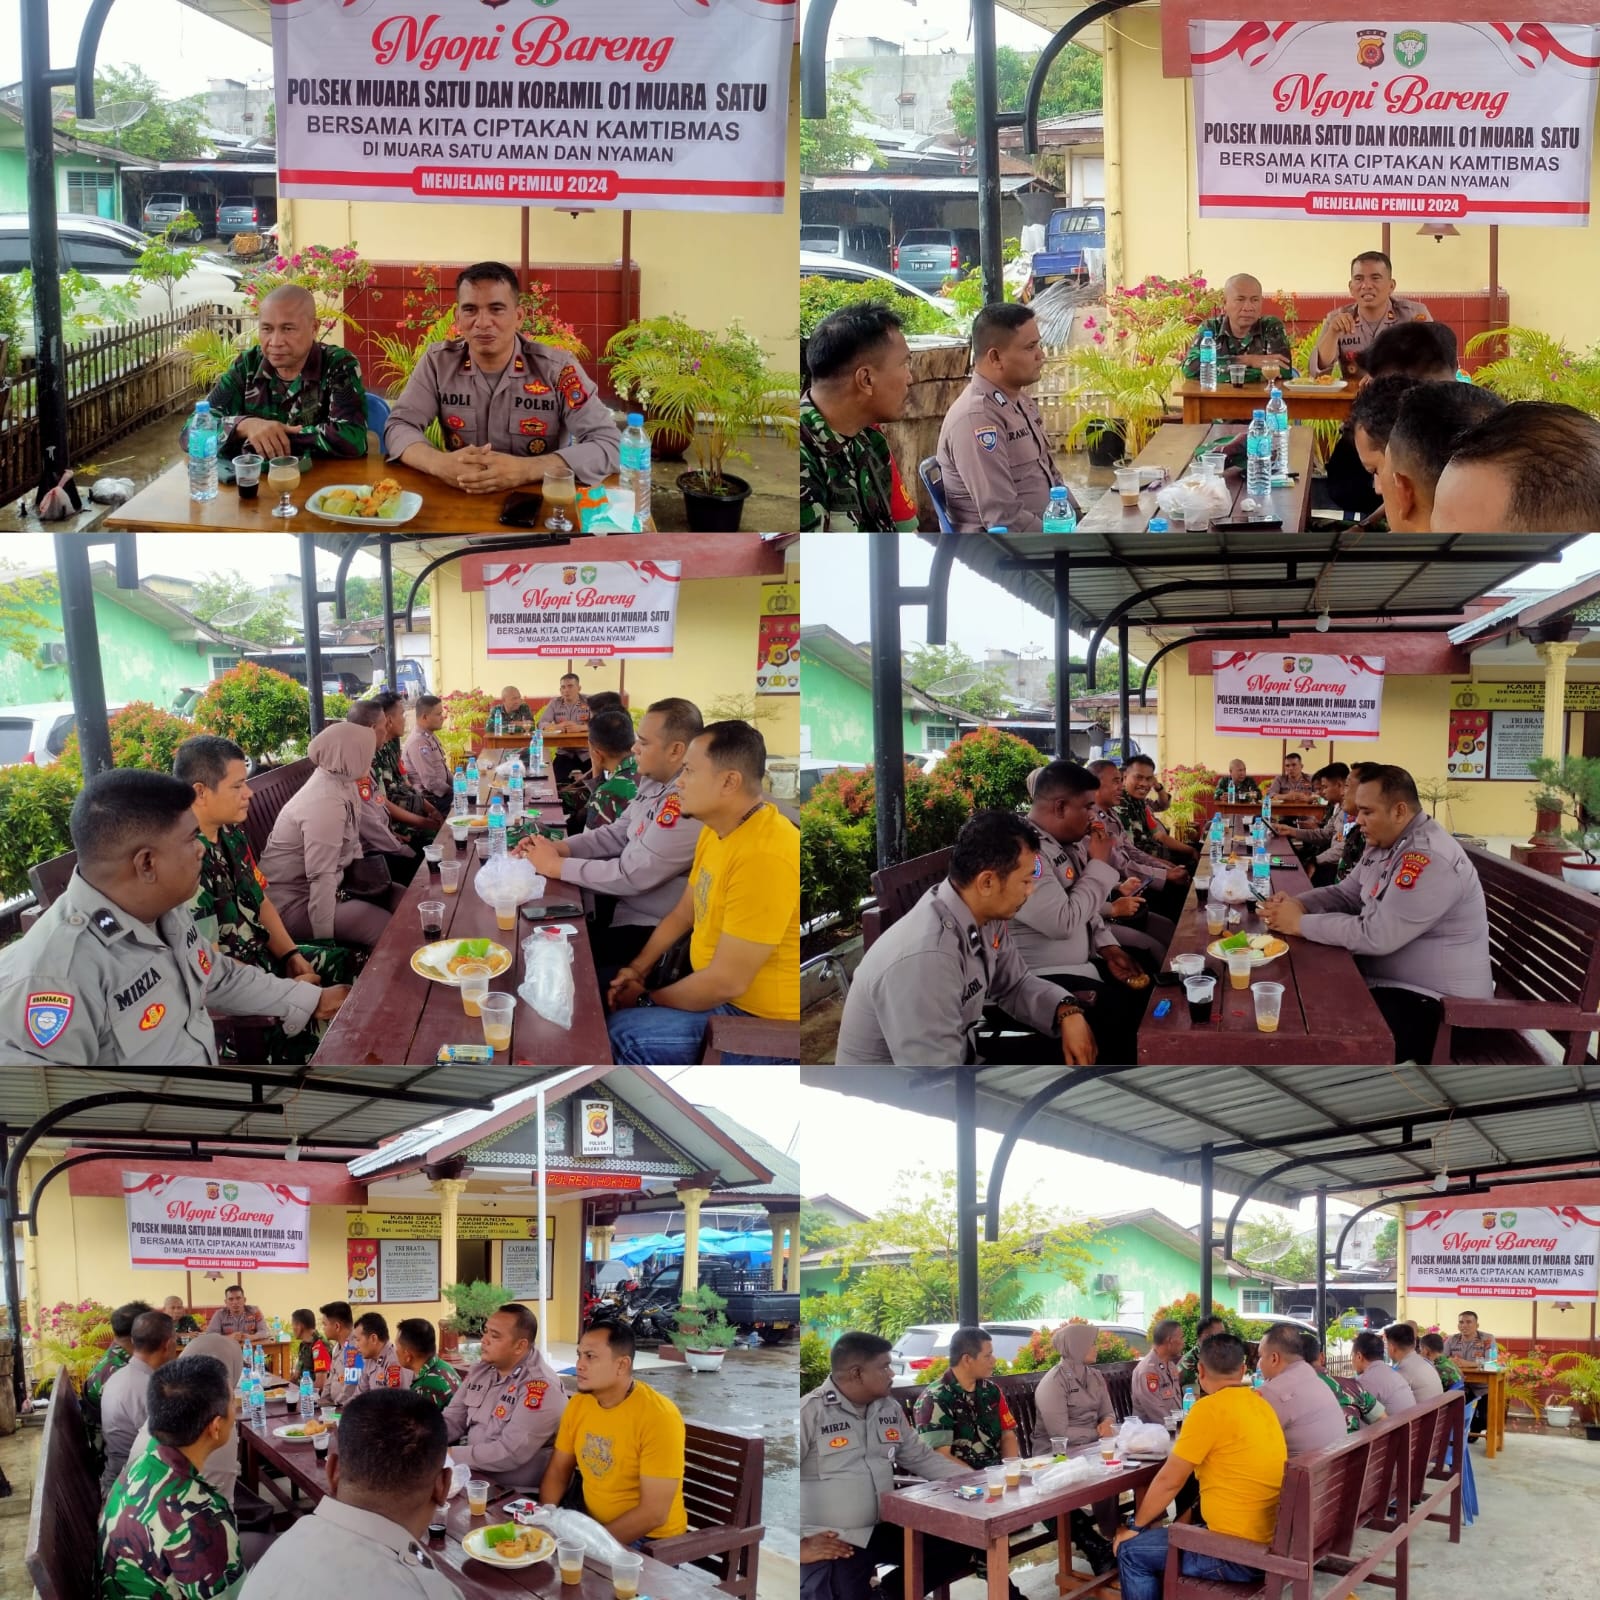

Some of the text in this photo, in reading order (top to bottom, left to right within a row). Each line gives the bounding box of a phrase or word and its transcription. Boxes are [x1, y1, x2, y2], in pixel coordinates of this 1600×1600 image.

[372, 14, 674, 72] Ngopi Bareng
[289, 79, 766, 112] POLSEK MUARA SATU DAN KORAMIL 01 MUARA SATU
[1273, 73, 1509, 118] Ngopi Bareng
[308, 116, 739, 141] BERSAMA KITA CIPTAKAN KAMTIBMAS
[1205, 123, 1579, 149] POLSEK MUARA SATU DAN KORAMIL 01 MUARA SATU
[364, 143, 672, 163] DI MUARA SATU AMAN DAN NYAMAN
[1220, 152, 1560, 171] BERSAMA KITA CIPTAKAN KAMTIBMAS
[422, 173, 606, 194] MENJELANG PEMILU 2024
[1265, 173, 1509, 188] DI MUARA SATU AMAN DAN NYAMAN
[1312, 197, 1458, 212] MENJELANG PEMILU 2024
[514, 396, 554, 410] POLRI
[523, 587, 636, 609] Ngopi Bareng
[490, 611, 669, 623] POLSEK MUARA SATU DAN KORAMIL 01 MUARA SATU
[1247, 675, 1346, 695] Ngopi Bareng
[1217, 695, 1375, 709] POLSEK MUARA SATU DAN KORAMIL 01 MUARA SATU
[114, 968, 162, 1011] MIRZA
[32, 996, 68, 1005] BINMAS
[167, 1200, 274, 1225] Ngopi Bareng
[132, 1222, 302, 1240] POLSEK MUARA SATU DAN KORAMIL 01 MUARA SATU
[140, 1236, 184, 1245] BERSAMA
[207, 1240, 247, 1248] CIPTAKAN
[1443, 1232, 1557, 1252] Ngopi Bareng
[1411, 1255, 1594, 1265] POLSEK MUARA SATU DAN KORAMIL 01 MUARA SATU
[821, 1421, 851, 1434] MIRZA
